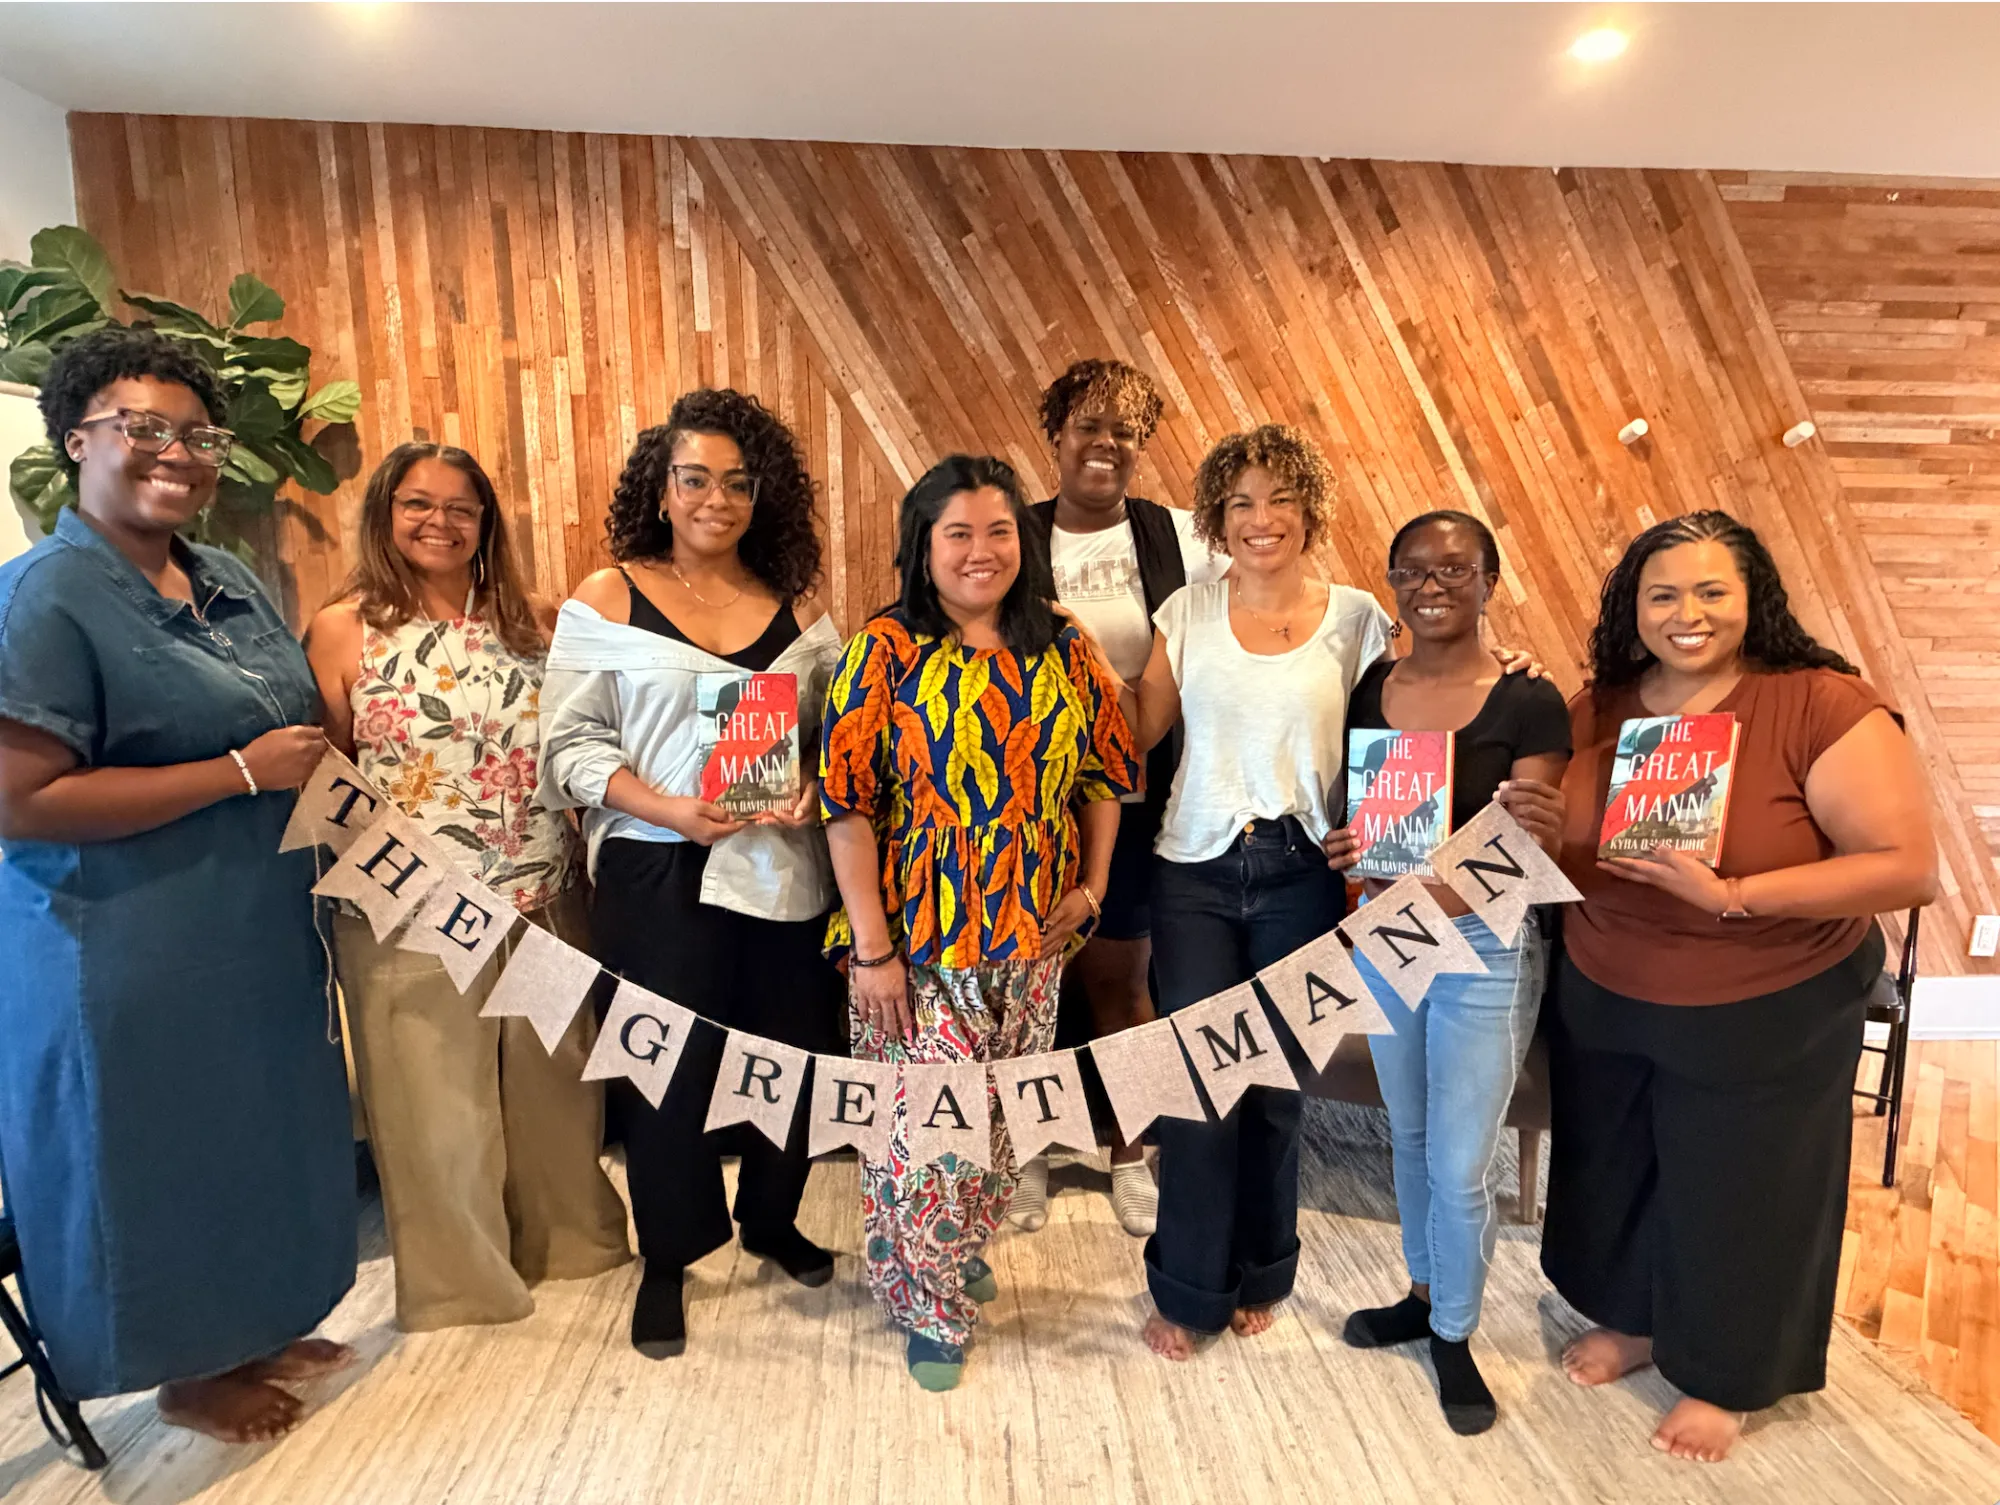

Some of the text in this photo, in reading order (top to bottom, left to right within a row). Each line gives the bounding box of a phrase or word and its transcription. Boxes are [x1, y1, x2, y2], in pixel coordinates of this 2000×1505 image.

[736, 680, 766, 701] THE
[715, 711, 789, 741] GREAT
[1661, 721, 1694, 743] THE
[1384, 737, 1413, 760] THE
[720, 754, 785, 784] MANN
[1629, 751, 1718, 781] GREAT
[1362, 769, 1436, 801] GREAT
[739, 800, 766, 812] DAVIS
[1623, 792, 1705, 822] MANN
[1364, 812, 1430, 845] MANN
[1610, 838, 1638, 850] KYRA
[1674, 838, 1707, 851] LURIE
[1381, 860, 1407, 873] DAVIS
[326, 776, 1529, 1131] THE GREAT MANN
